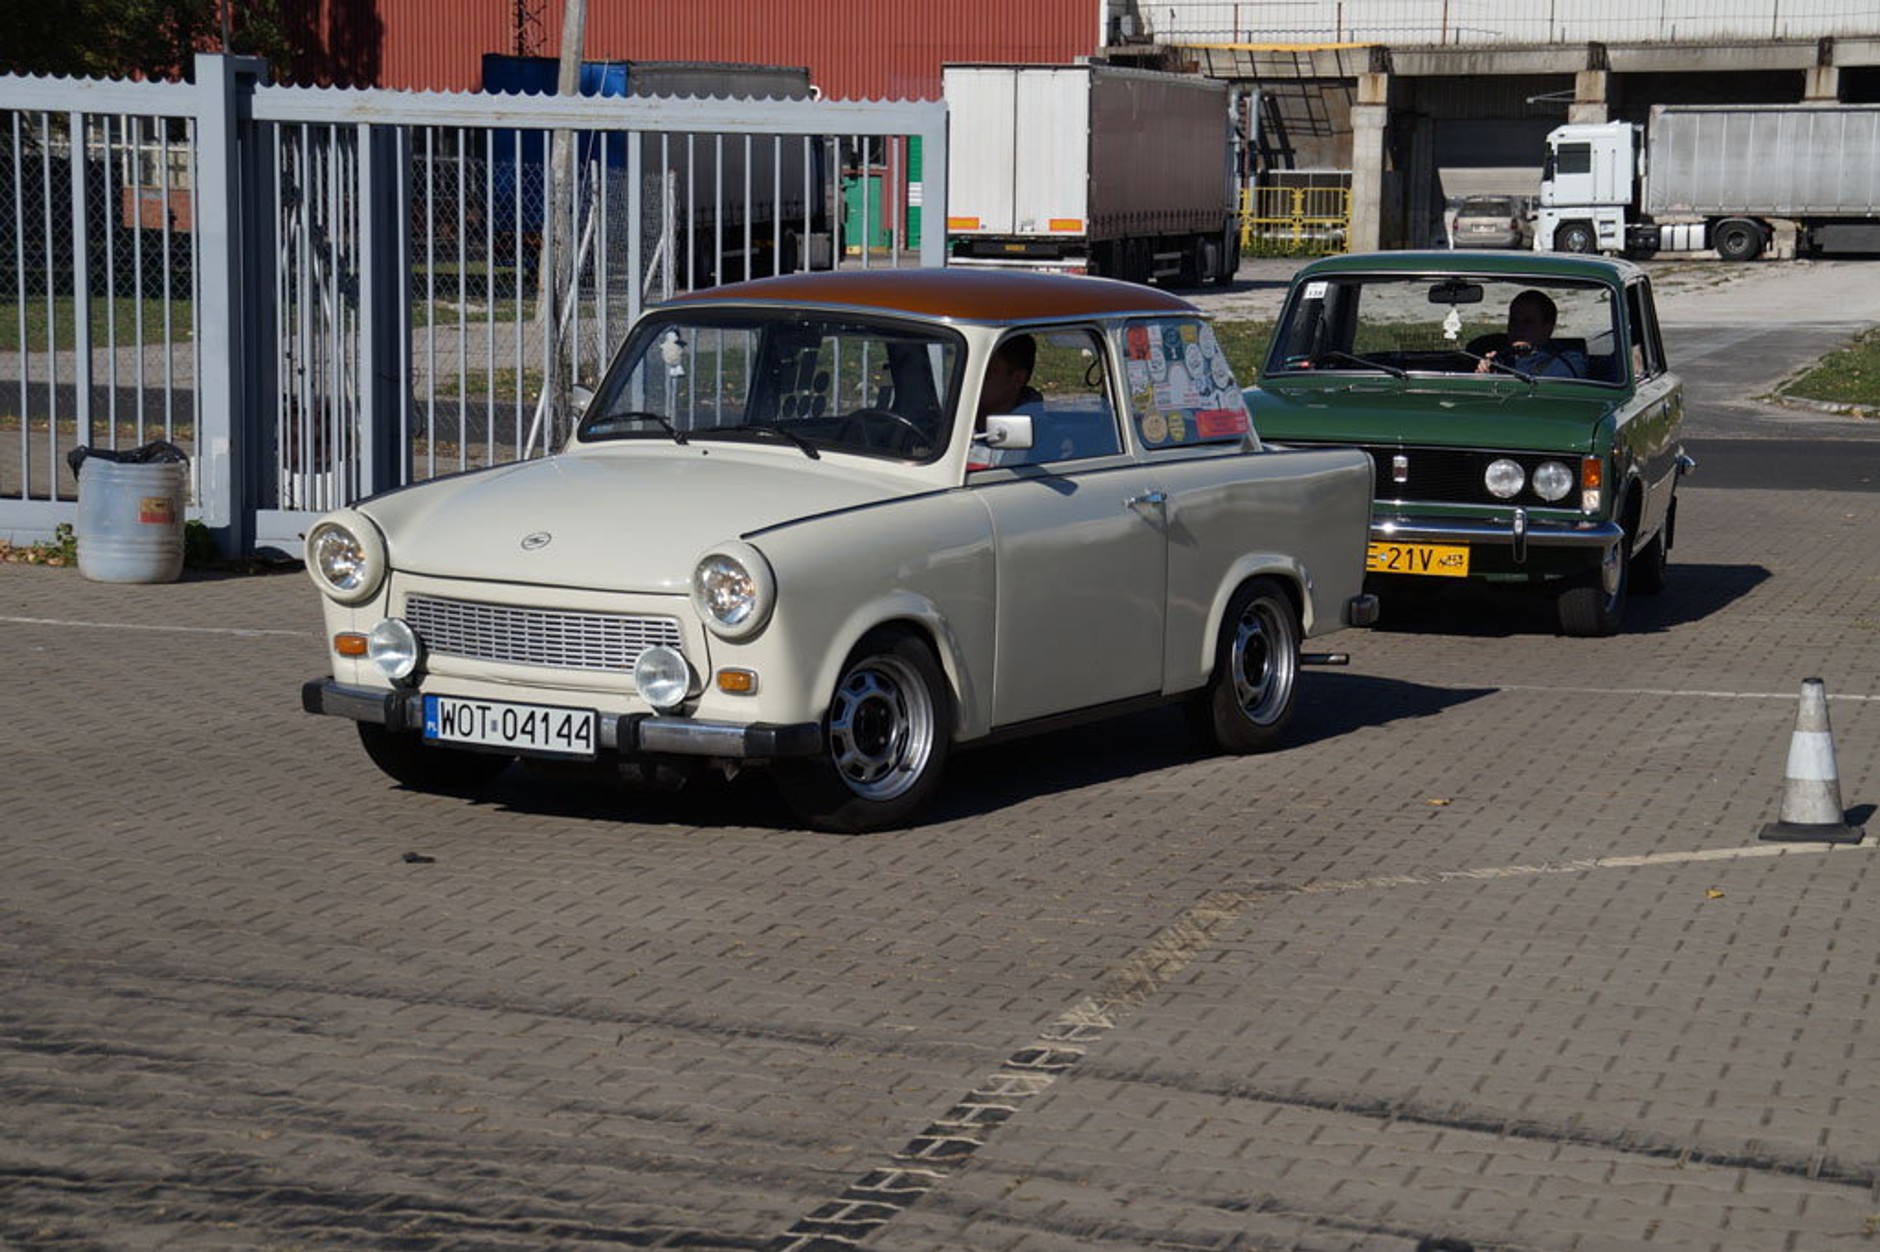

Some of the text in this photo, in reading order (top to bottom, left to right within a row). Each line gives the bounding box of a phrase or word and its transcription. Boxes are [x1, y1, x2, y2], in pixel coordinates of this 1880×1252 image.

[1388, 547, 1433, 571] 21V
[441, 702, 590, 749] WOT 04144
